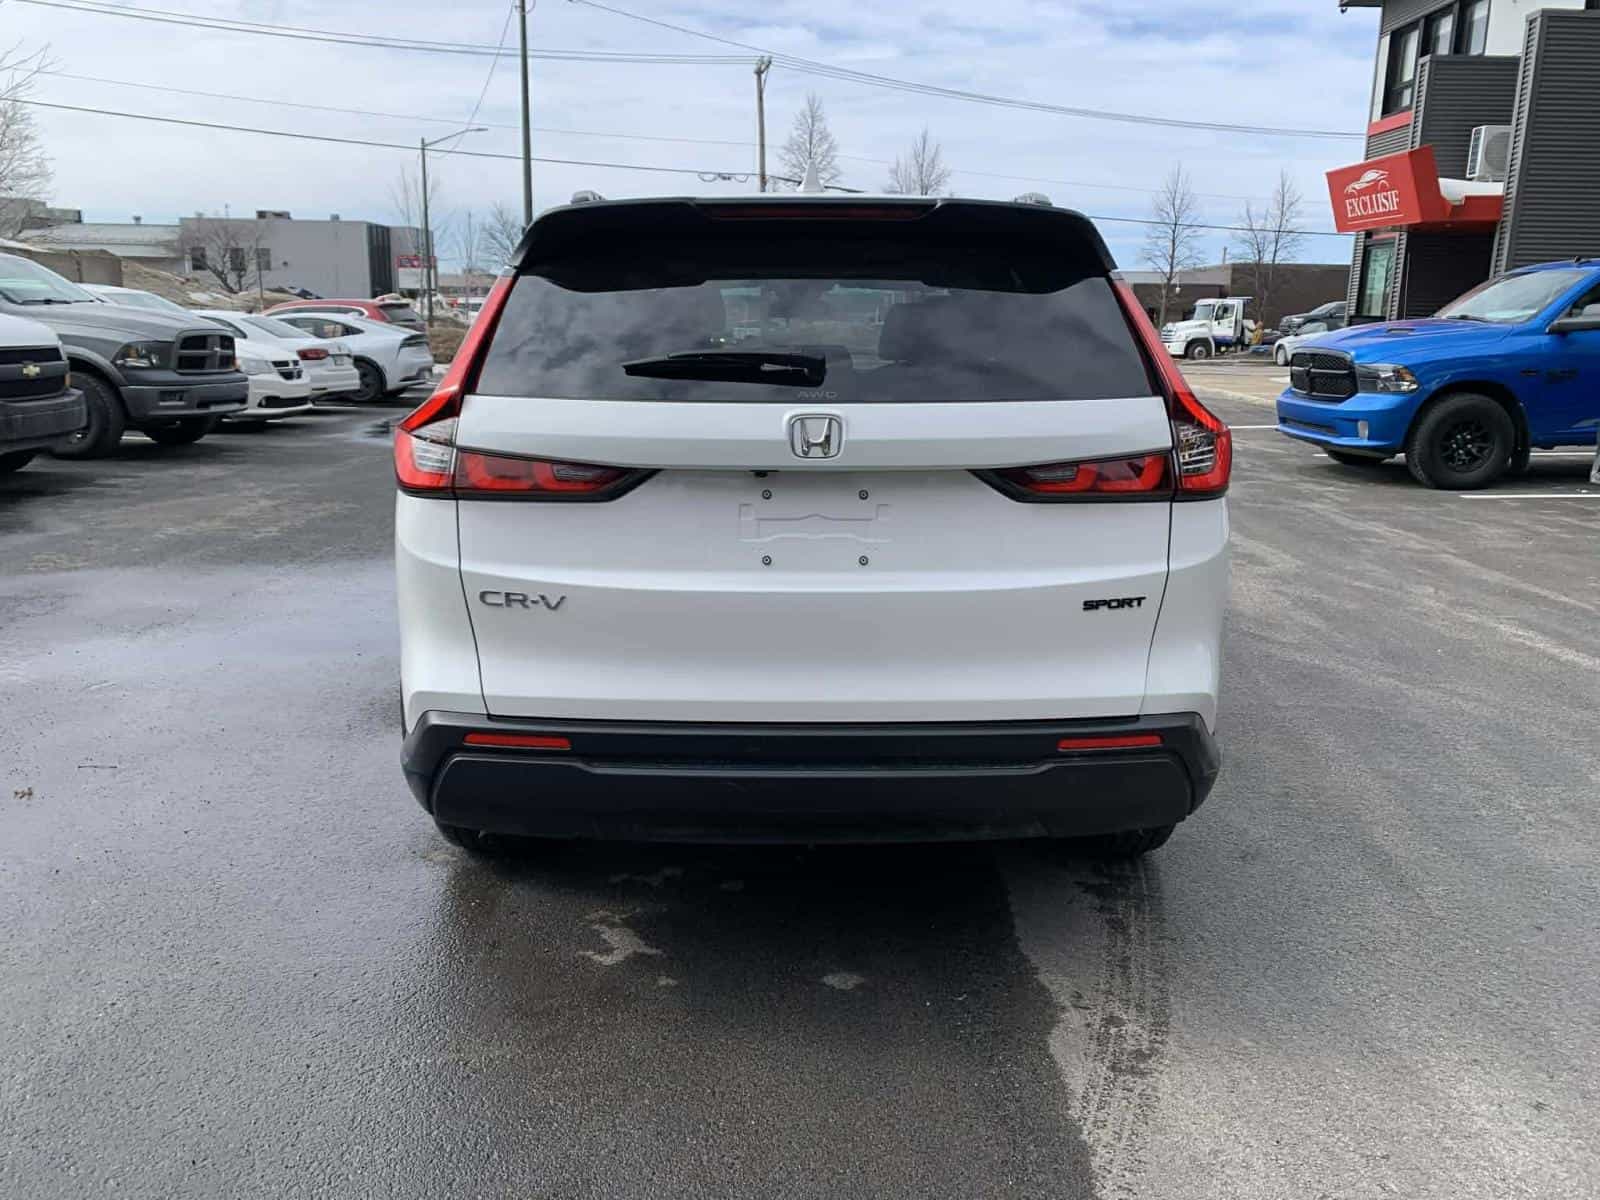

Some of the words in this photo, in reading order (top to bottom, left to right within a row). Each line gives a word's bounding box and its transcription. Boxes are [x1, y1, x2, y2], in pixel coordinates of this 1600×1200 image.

[1345, 190, 1400, 218] EXCLUSIF
[797, 391, 838, 400] AWD
[479, 590, 567, 611] CR-V
[1082, 596, 1147, 611] SPORT
